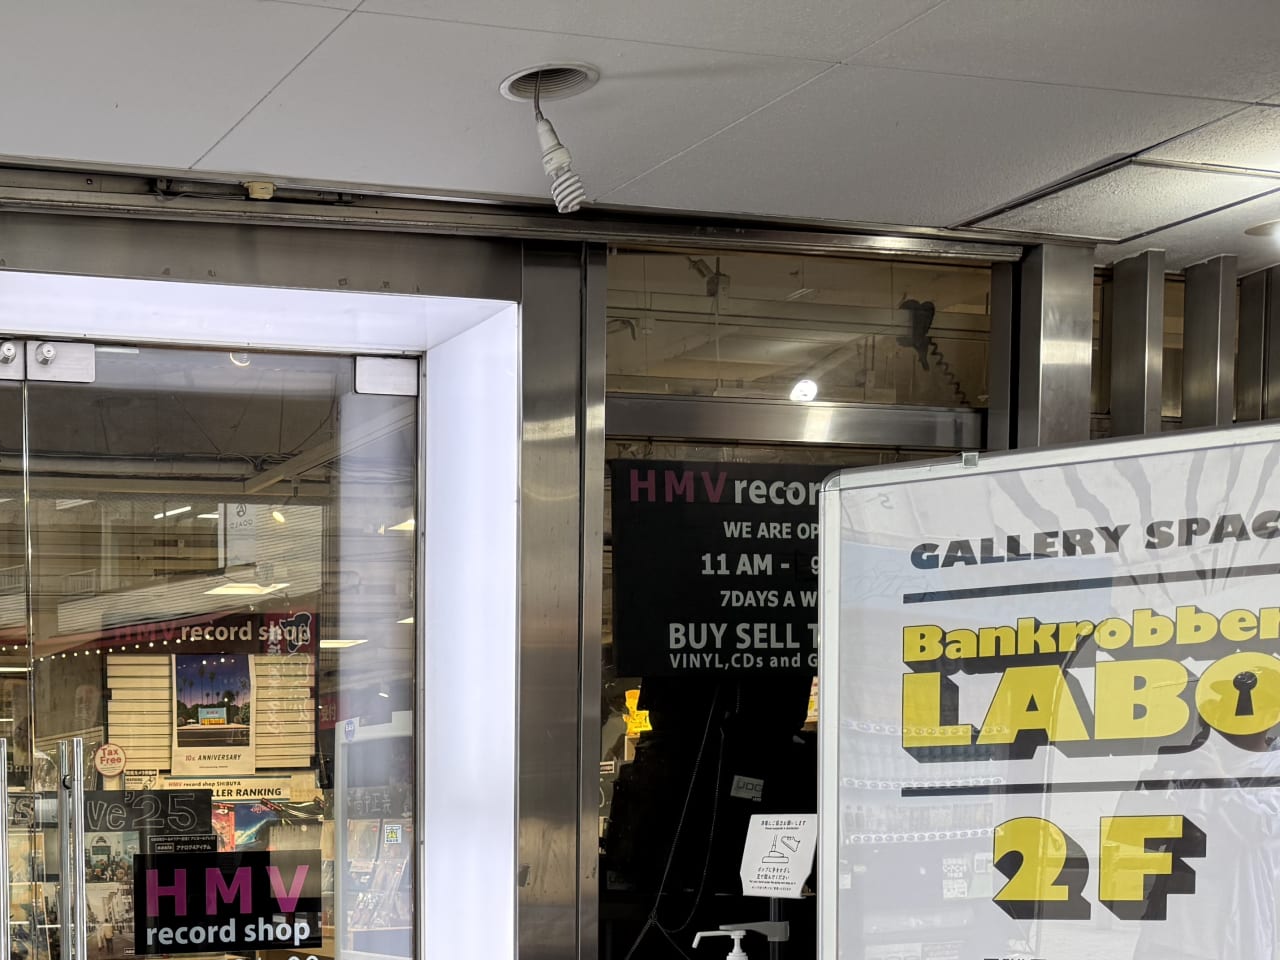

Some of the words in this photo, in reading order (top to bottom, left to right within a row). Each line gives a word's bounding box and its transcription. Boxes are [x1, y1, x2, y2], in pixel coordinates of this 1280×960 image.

[630, 469, 728, 503] HMV
[724, 521, 752, 539] WE
[757, 522, 792, 539] ARE
[909, 523, 1130, 570] GALLERY
[1144, 510, 1280, 550] SPAC
[701, 553, 730, 576] 11
[735, 553, 773, 576] AM
[720, 590, 778, 608] 7DAYS
[783, 591, 795, 607] A
[181, 620, 252, 641] record
[669, 623, 728, 649] BUY
[736, 623, 801, 649] SELL
[902, 604, 1280, 672] Bankrobber
[770, 653, 801, 668] and
[902, 650, 1280, 762] LABO
[100, 748, 119, 757] Tax
[100, 756, 122, 764] Free
[197, 754, 242, 762] ANNIVERSARY
[213, 788, 233, 797] LER
[236, 787, 282, 797] RANKING
[992, 814, 1202, 916] 2F
[146, 865, 310, 917] HMV
[146, 918, 236, 945] record
[244, 917, 311, 946] shop
